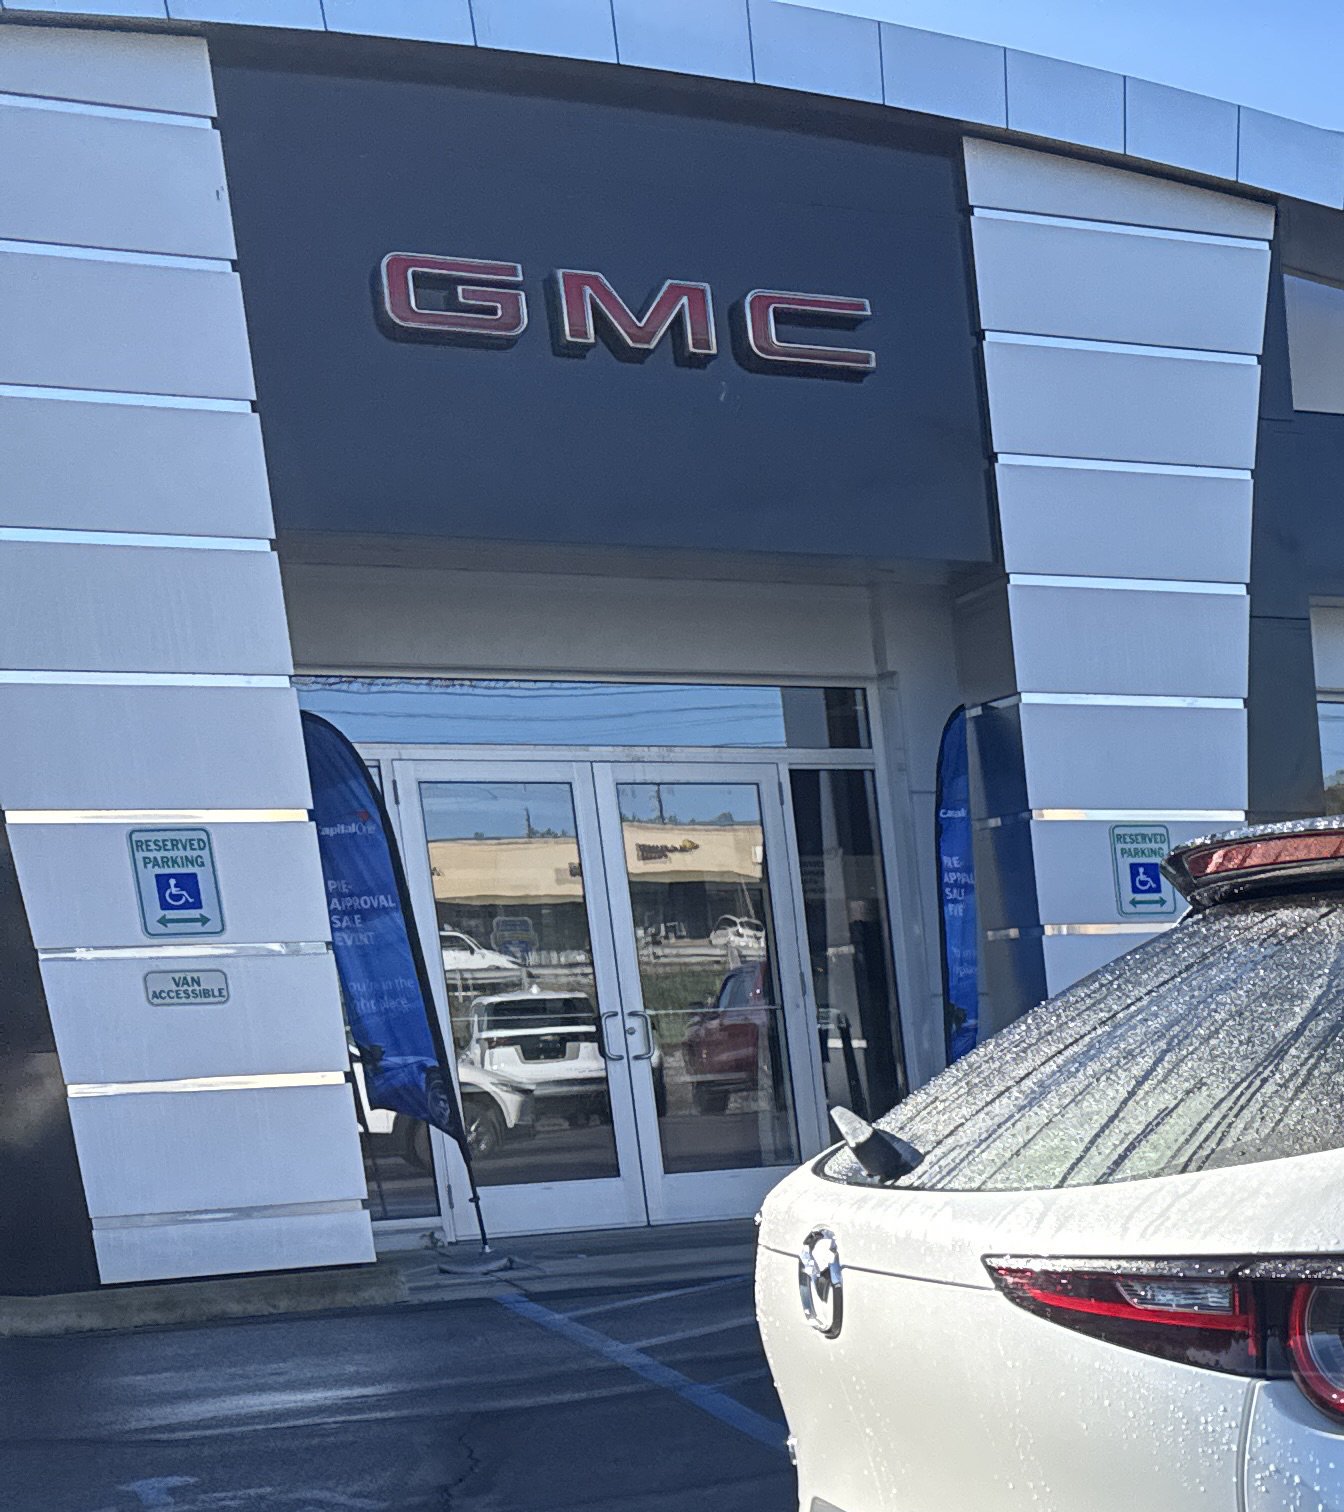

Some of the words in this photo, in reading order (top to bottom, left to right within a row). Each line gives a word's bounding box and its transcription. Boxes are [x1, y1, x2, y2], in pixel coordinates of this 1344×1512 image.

[381, 250, 876, 368] GMC
[134, 838, 207, 852] RESERVED
[1115, 833, 1167, 845] RESERVED
[1120, 847, 1165, 858] PARKING
[142, 855, 206, 869] PARKING
[331, 914, 363, 929] SAE
[171, 975, 202, 988] VAN
[151, 987, 226, 1001] ACCESSIBLE
